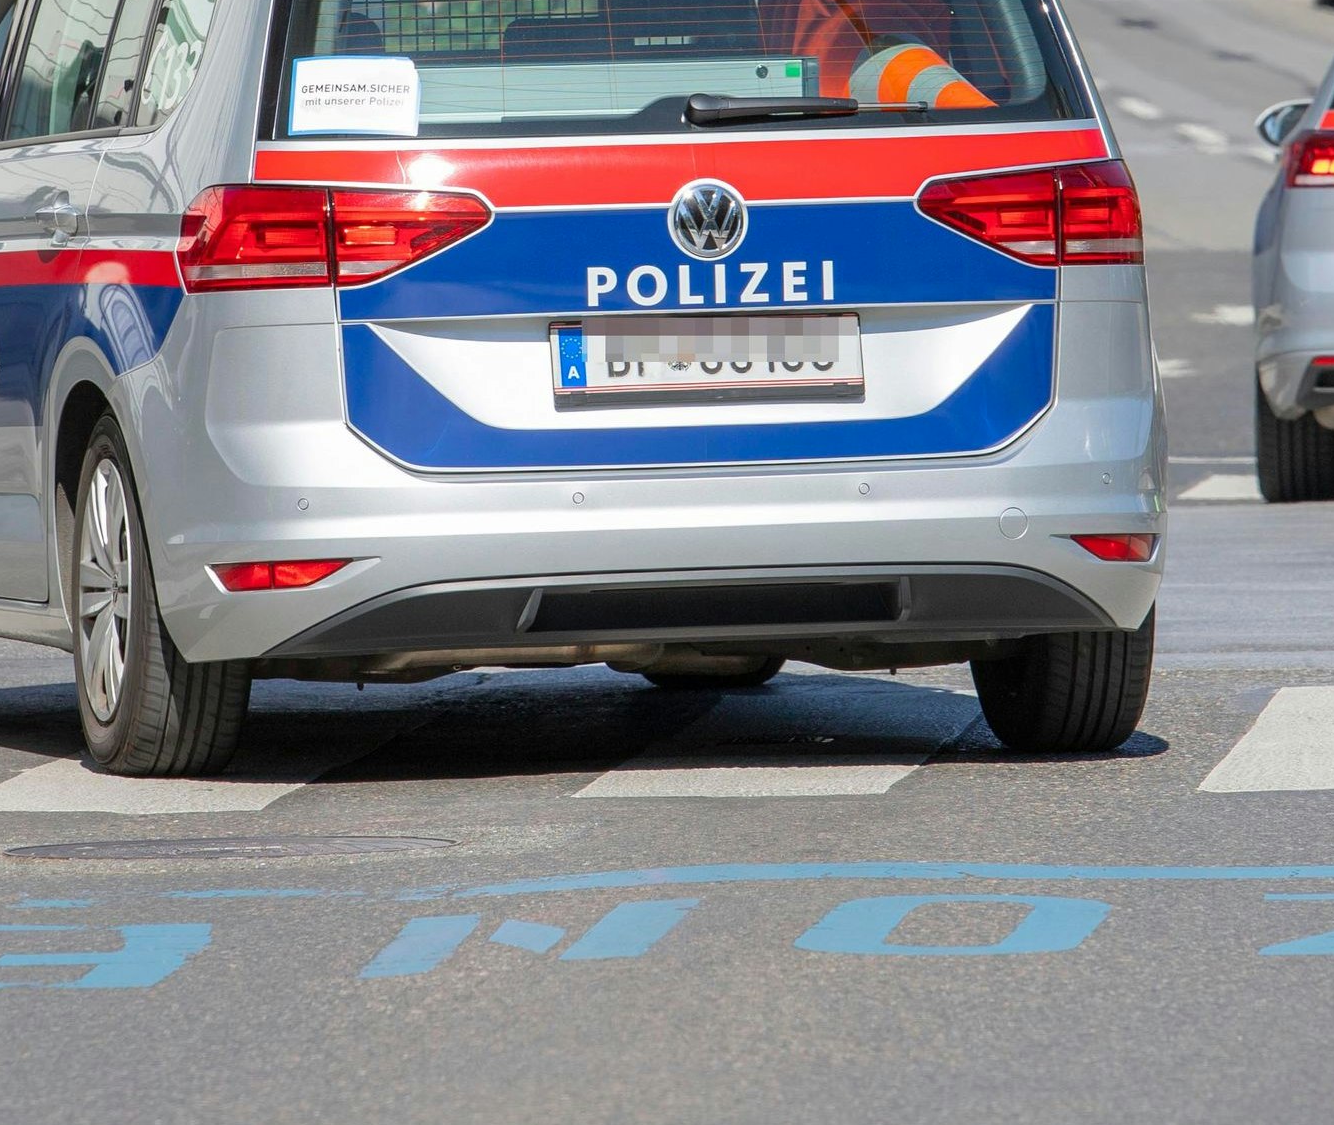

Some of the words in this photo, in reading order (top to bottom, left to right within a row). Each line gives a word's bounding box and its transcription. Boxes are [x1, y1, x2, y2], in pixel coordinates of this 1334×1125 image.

[301, 83, 411, 94] GEMEINSAM.SICHER
[305, 96, 321, 106] mit
[325, 96, 366, 106] unserer
[587, 260, 834, 307] POLIZEI
[568, 365, 580, 379] A
